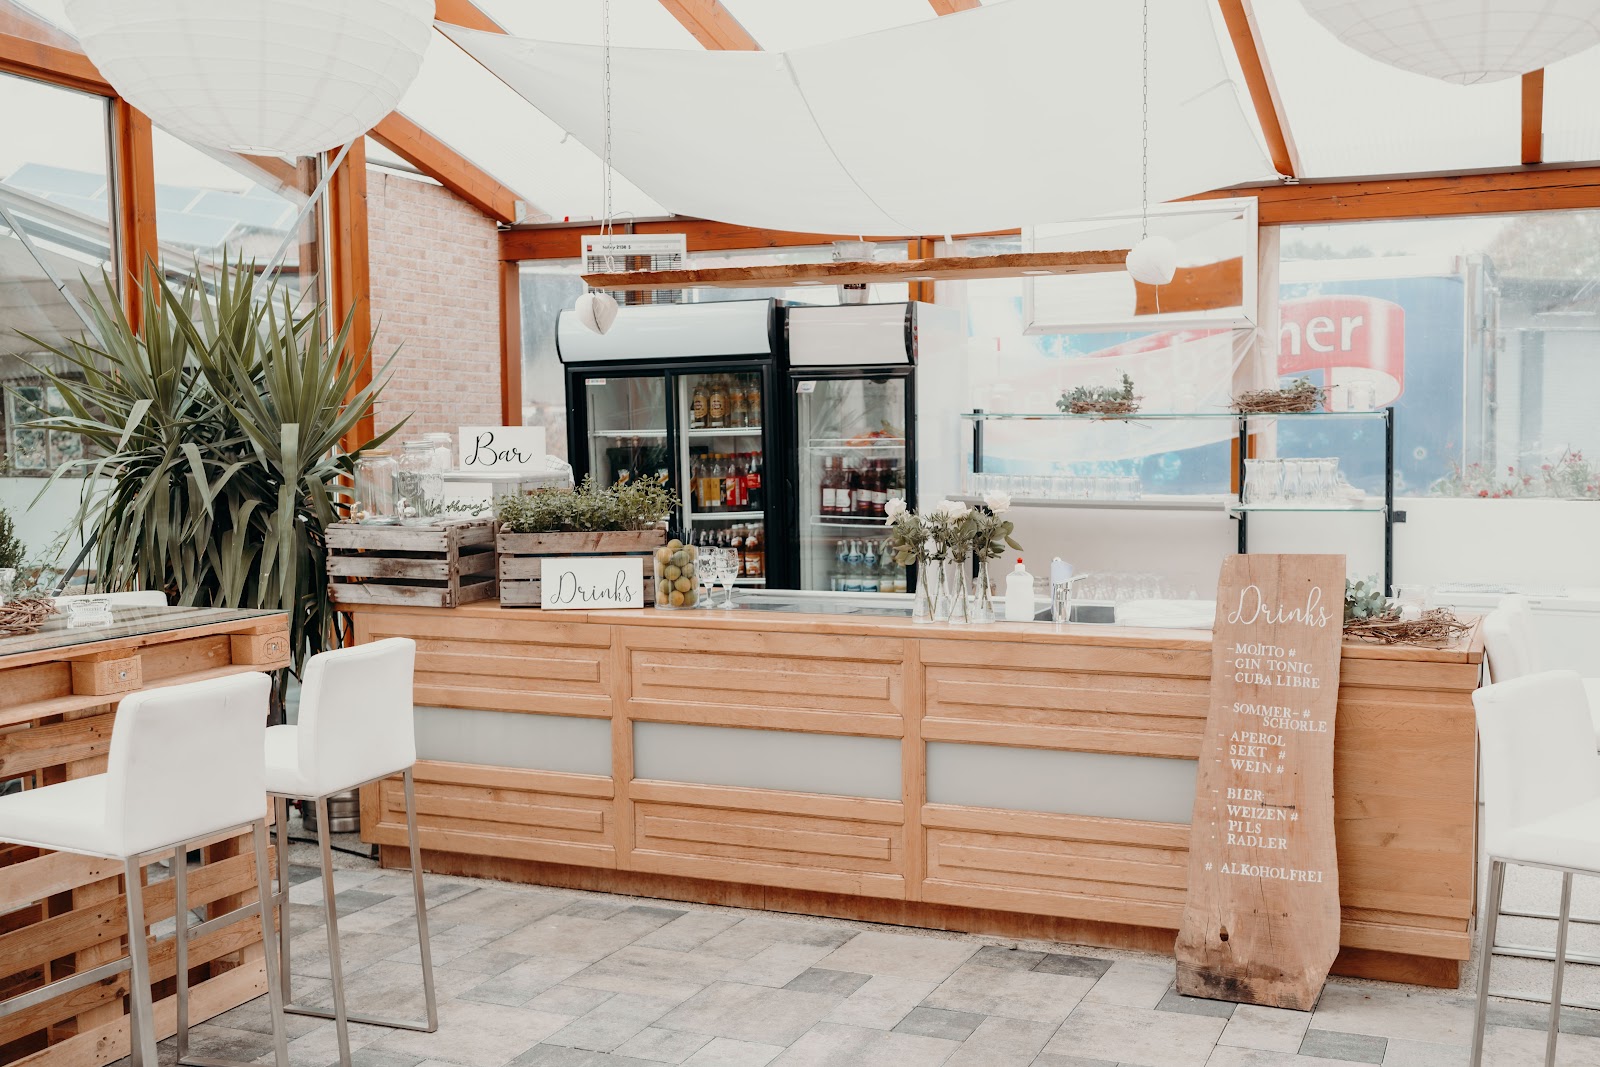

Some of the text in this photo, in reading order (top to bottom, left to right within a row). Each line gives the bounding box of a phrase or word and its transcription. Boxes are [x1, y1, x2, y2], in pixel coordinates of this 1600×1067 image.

[1278, 309, 1364, 355] her
[465, 431, 533, 466] Bar
[550, 570, 637, 604] Drinks
[1228, 584, 1333, 628] Drinks
[1235, 643, 1285, 657] MOJITO
[1235, 658, 1313, 674] GIN TONIC
[1235, 672, 1320, 688] CUBA LIBRE
[1262, 716, 1327, 732] SCHORLE
[1230, 731, 1286, 746] APEROL
[1229, 745, 1267, 758] SEKT
[1230, 758, 1272, 773] WEIN
[1227, 804, 1287, 821] WEIZEN
[1228, 819, 1261, 834] PILS
[1227, 833, 1287, 850] RADLER
[1220, 862, 1323, 883] ALKOHOLFREI
